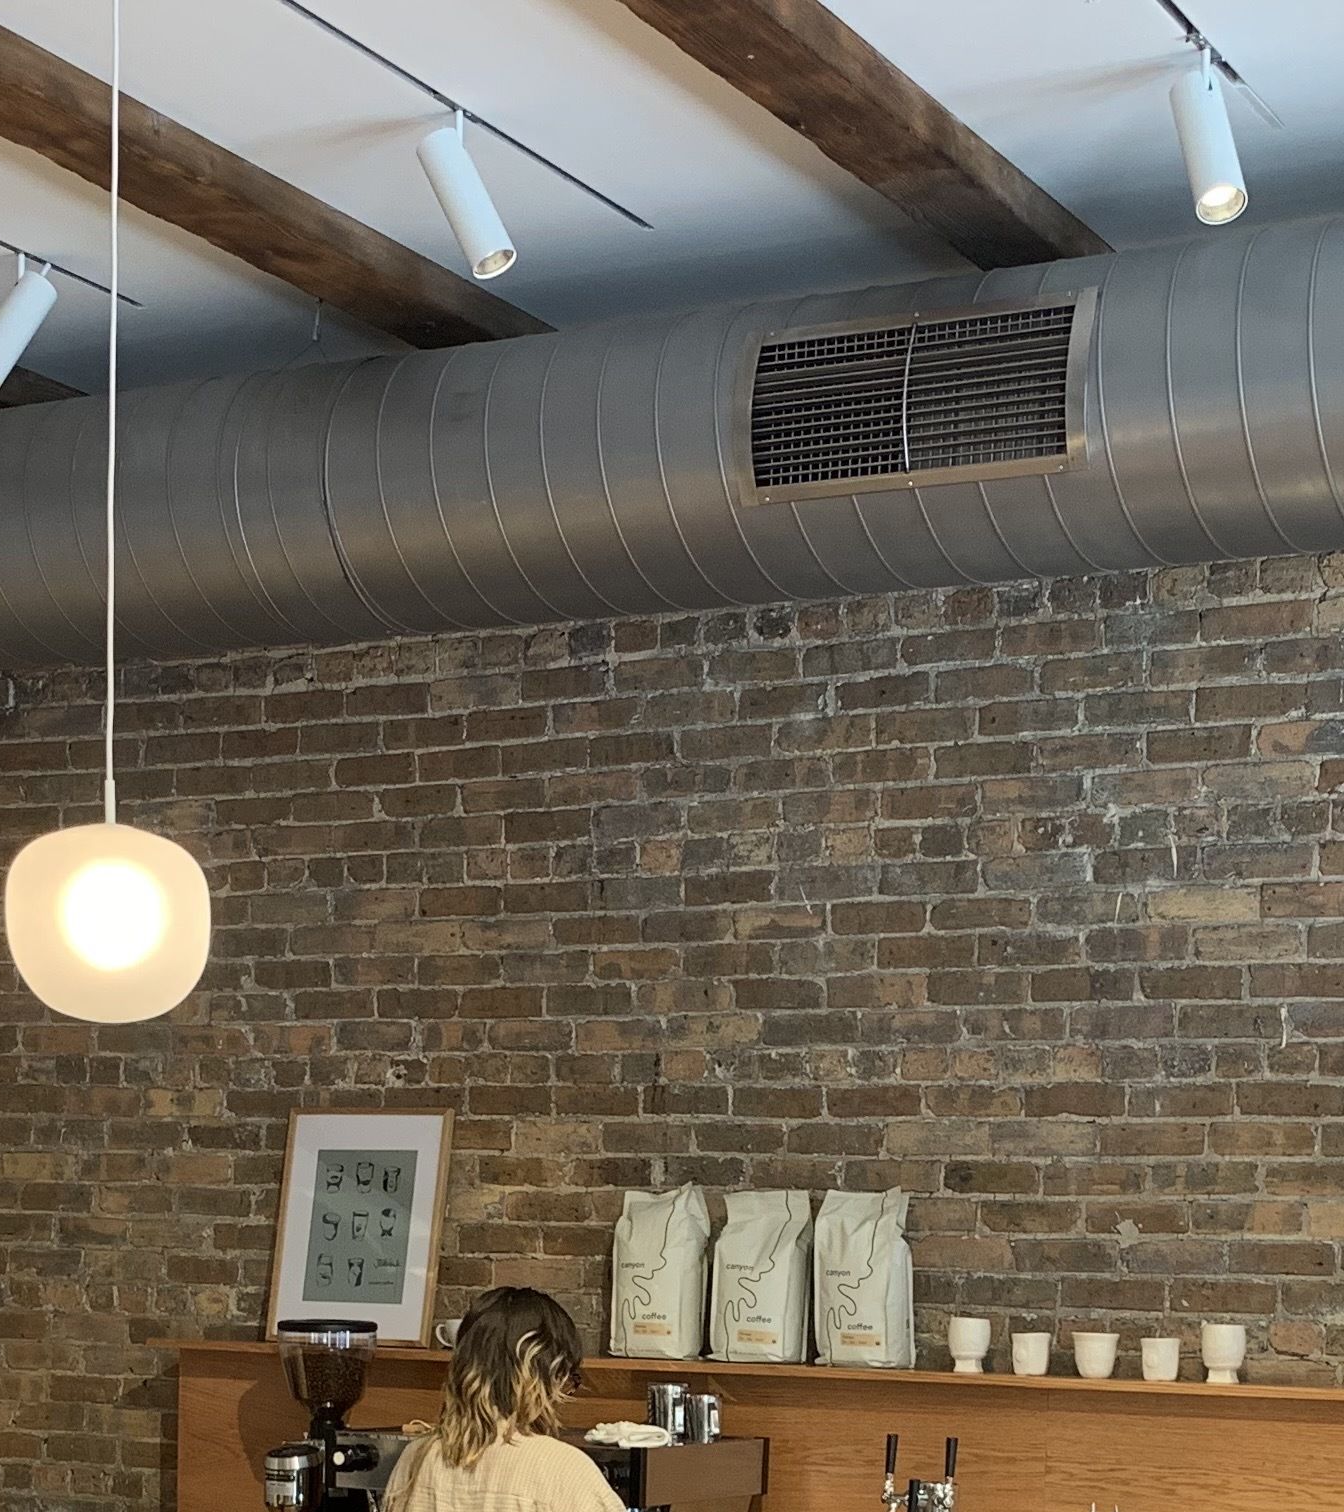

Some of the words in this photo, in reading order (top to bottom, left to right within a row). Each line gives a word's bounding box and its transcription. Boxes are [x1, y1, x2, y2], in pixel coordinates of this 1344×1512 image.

[620, 1262, 645, 1270] canyon
[825, 1269, 851, 1277] canyon
[641, 1312, 668, 1320] coffee
[746, 1315, 773, 1324] coffee
[847, 1322, 874, 1331] coffee
